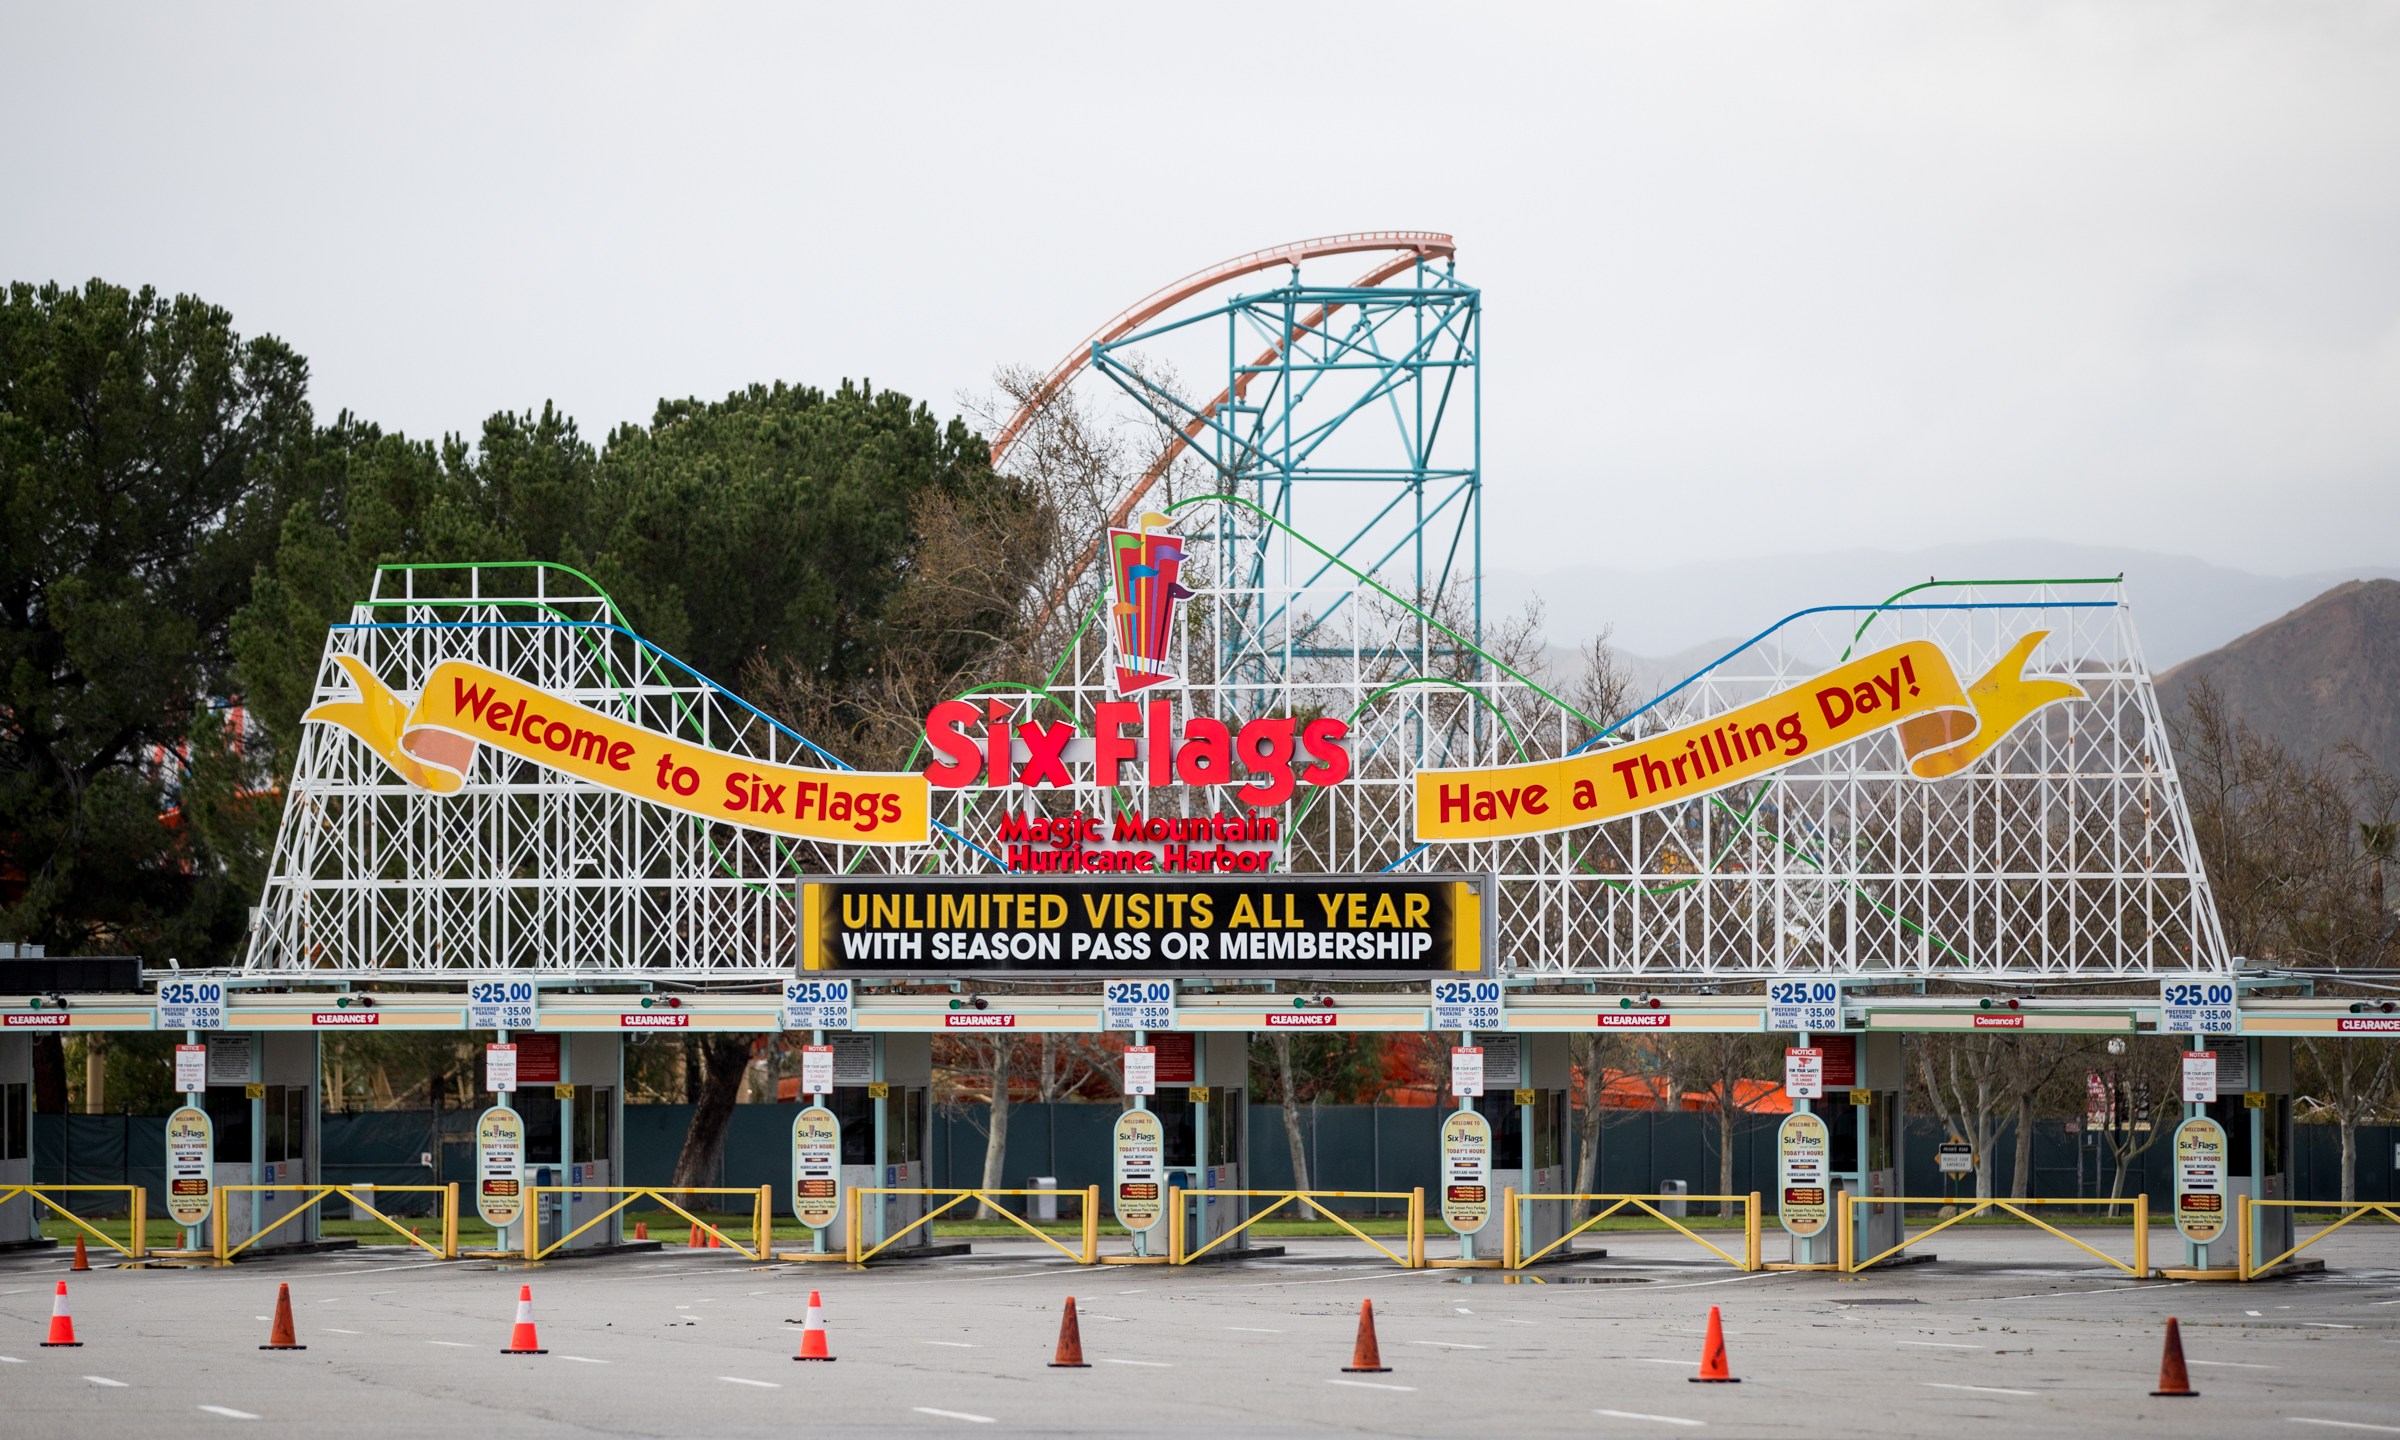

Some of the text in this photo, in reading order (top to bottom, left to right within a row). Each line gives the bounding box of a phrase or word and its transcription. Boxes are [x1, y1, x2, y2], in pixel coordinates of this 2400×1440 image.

[1439, 654, 1922, 824] Have a Thrilling Day!
[454, 677, 903, 832] Welcome to Six Flags
[923, 698, 1351, 808] Six Flags
[998, 808, 1279, 849] Magic Mountain
[1008, 843, 1272, 873] Hurricane Harbor
[842, 894, 1431, 929] UNLIMITED VISITS ALL YEAR
[841, 932, 1433, 960] WITH SEASON PASS OR MEMBERSHIP
[162, 984, 220, 1003] $25.00
[472, 983, 531, 1003] $25.00
[788, 983, 847, 1003] $25.00
[1108, 984, 1169, 1003] $25.00
[1436, 983, 1499, 1003] $25.00
[1772, 983, 1836, 1003] $25.00
[2165, 985, 2232, 1005] $25.00
[192, 1008, 219, 1016] $35.00
[503, 1007, 531, 1015] $35.00
[819, 1007, 847, 1015] $35.00
[1140, 1008, 1169, 1016] $35.00
[1469, 1007, 1498, 1016] $35.00
[1805, 1008, 1835, 1016] $35.00
[2200, 1010, 2231, 1019] $35.00
[8, 1015, 67, 1024] CLEARANCE 9'
[192, 1019, 219, 1027] $45.00
[317, 1014, 376, 1023] CLEARANCE 9'
[503, 1018, 530, 1026] $45.00
[625, 1015, 686, 1025] CLEARANCE 9'
[819, 1018, 847, 1027] $45.00
[950, 1015, 1012, 1025] CLEARANCE 9'
[1271, 1015, 1332, 1024] CLEARANCE 9'
[1603, 1015, 1666, 1025] CLEARANCE 9'
[1140, 1019, 1169, 1028] $45.00
[1469, 1019, 1498, 1028] $45.00
[1805, 1020, 1835, 1028] $45.00
[2200, 1022, 2231, 1031] $45.00
[2342, 1020, 2400, 1029] CLEARANCE
[188, 1130, 205, 1138] Flags
[499, 1130, 517, 1138] Flags
[814, 1130, 833, 1139] Flags
[1137, 1133, 1155, 1141] Flags
[1464, 1135, 1483, 1143] Flags
[1802, 1136, 1821, 1145] Flags
[2198, 1142, 2218, 1150] Flags
